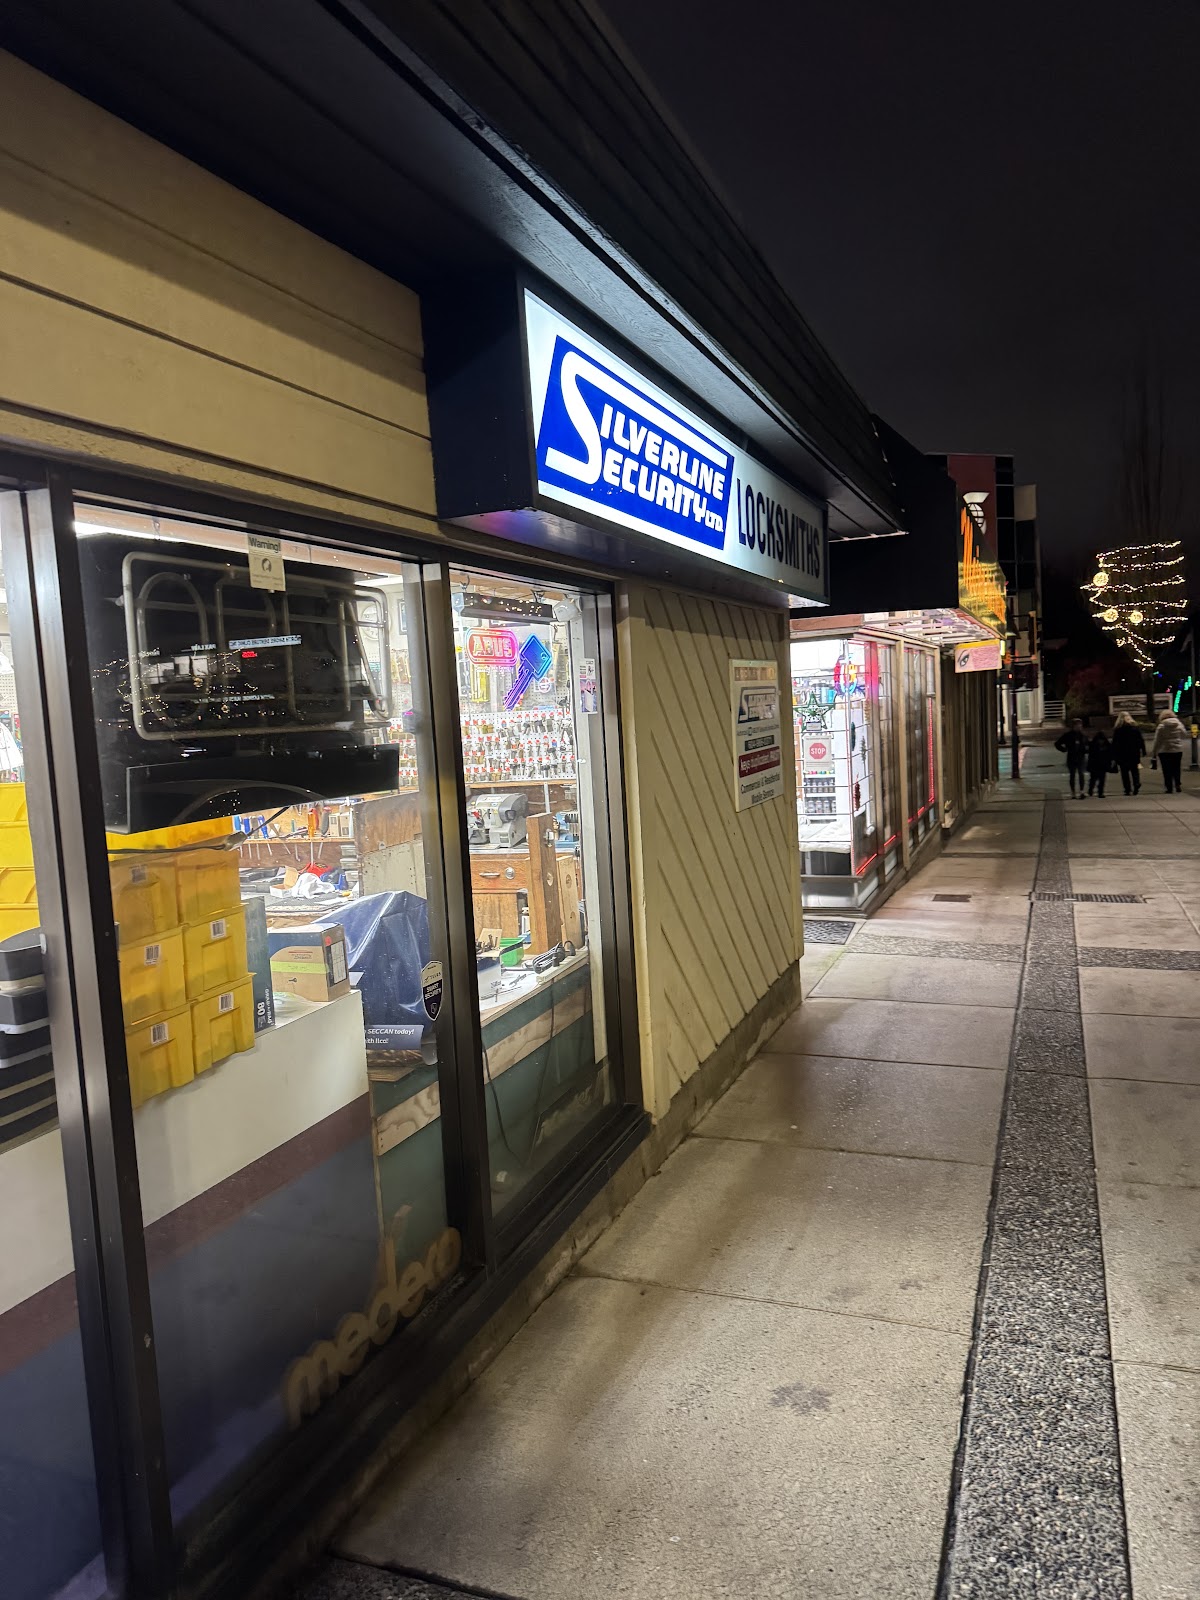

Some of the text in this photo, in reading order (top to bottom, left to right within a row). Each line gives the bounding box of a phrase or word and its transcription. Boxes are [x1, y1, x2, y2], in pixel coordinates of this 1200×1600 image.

[545, 351, 728, 501] SILVERLINE
[736, 477, 820, 579] LOCKSMITHS
[248, 536, 281, 554] Warning!
[473, 636, 512, 657] ABUS
[810, 747, 826, 755] STOP
[257, 1001, 266, 1016] 80
[394, 1028, 415, 1036] today!
[286, 1207, 460, 1424] medeco
